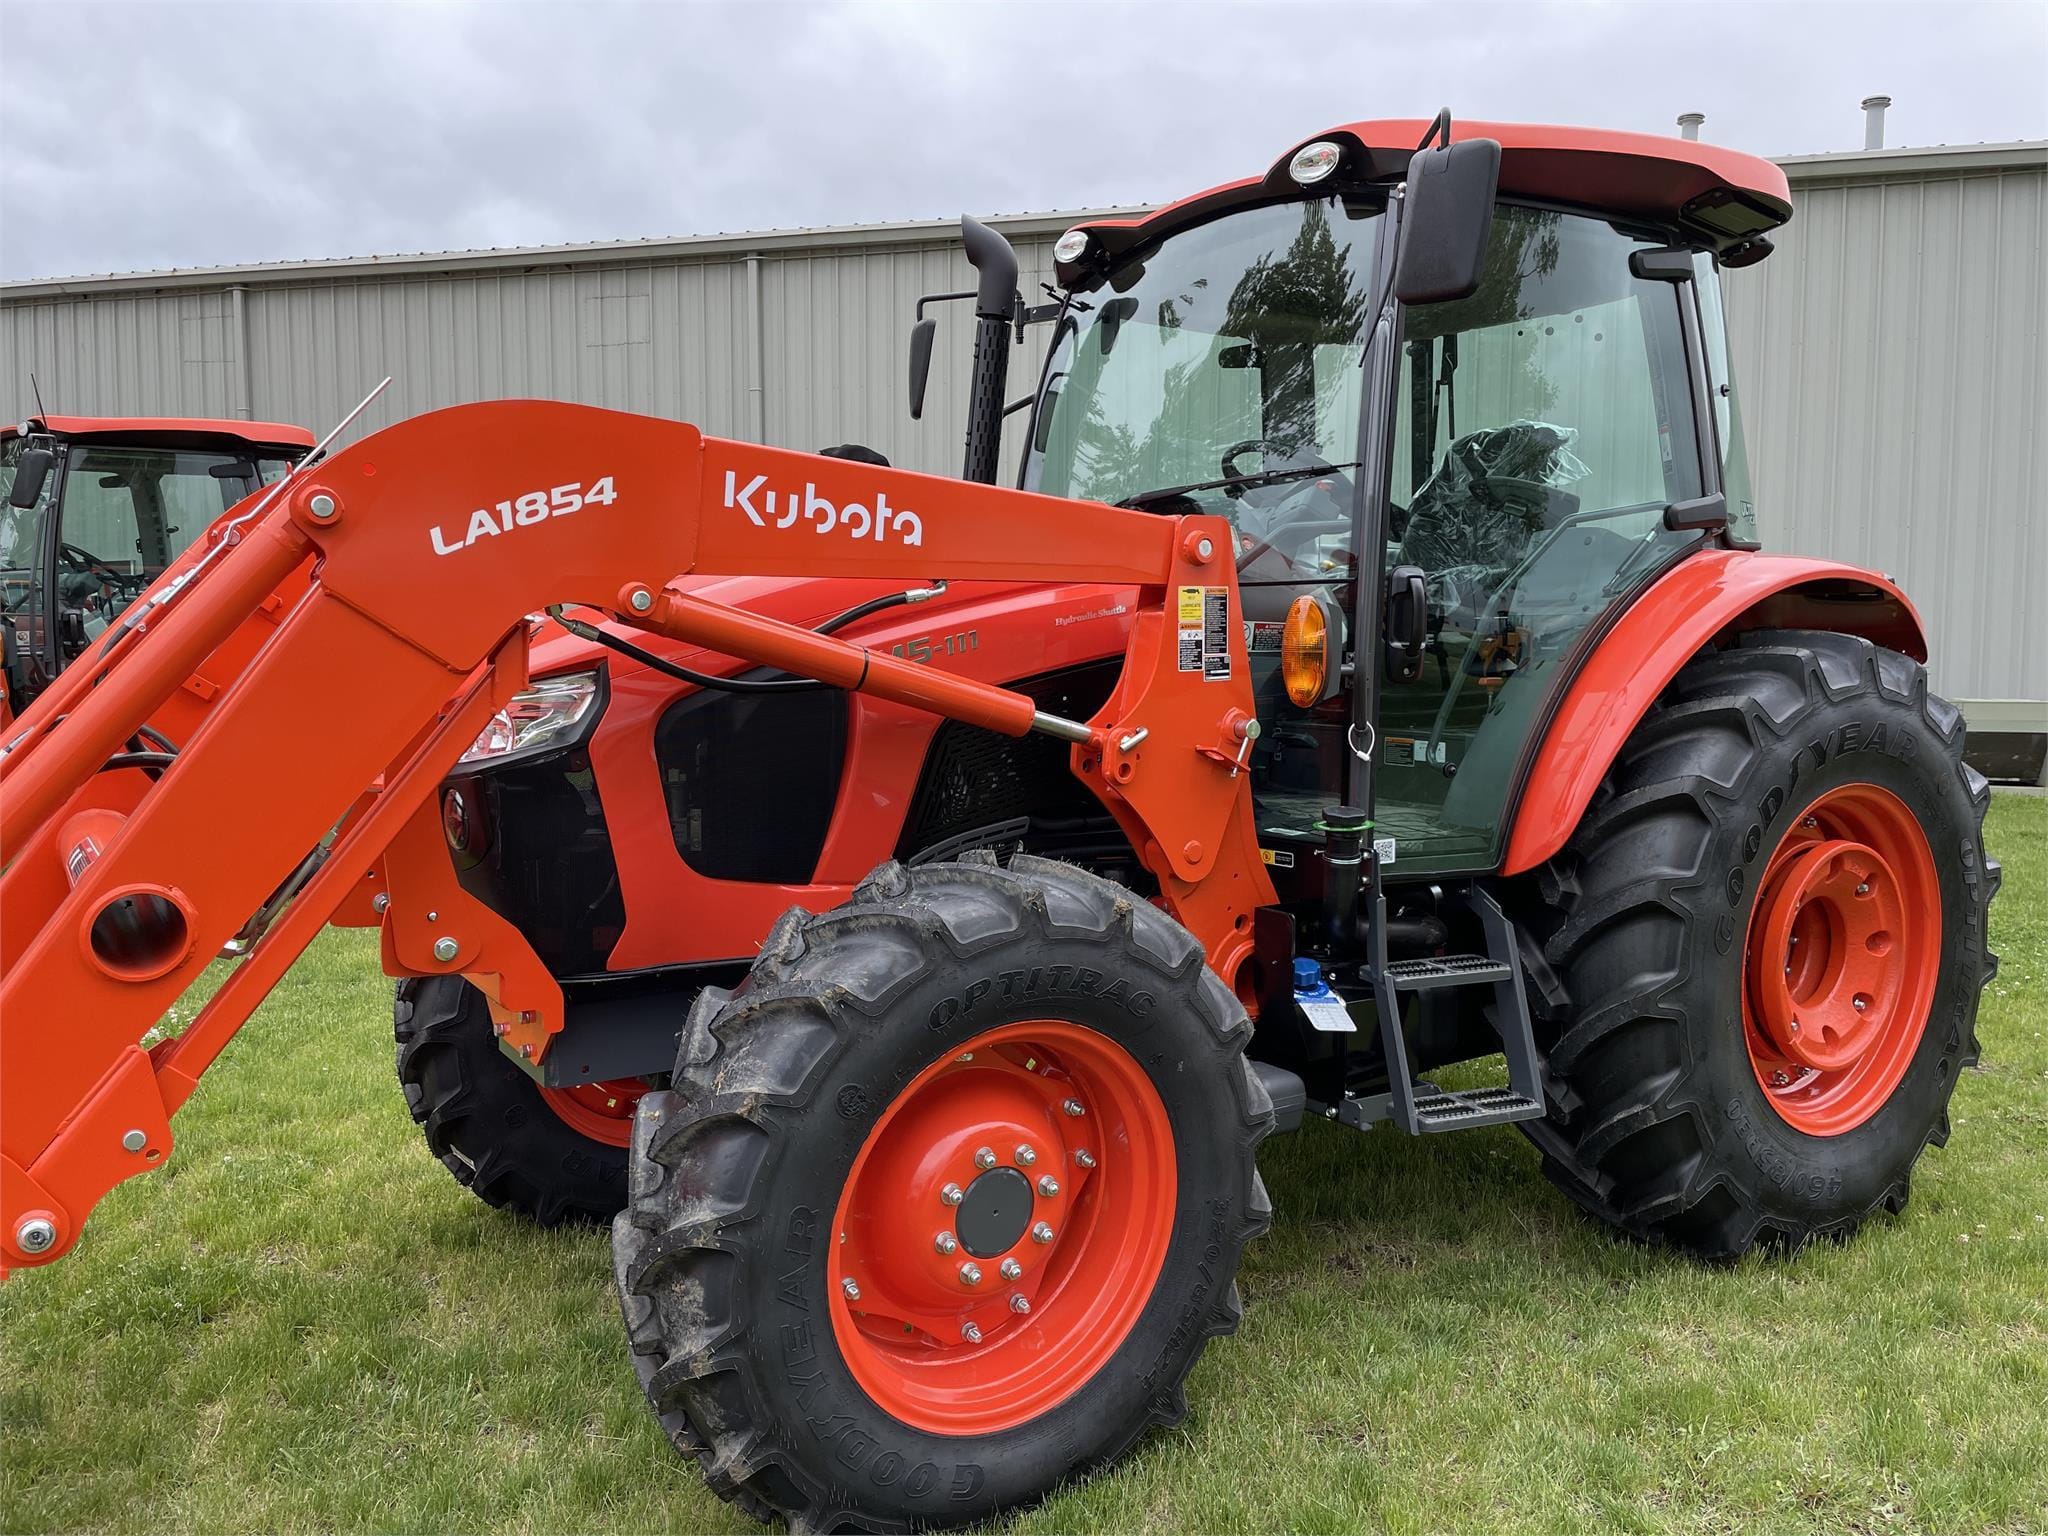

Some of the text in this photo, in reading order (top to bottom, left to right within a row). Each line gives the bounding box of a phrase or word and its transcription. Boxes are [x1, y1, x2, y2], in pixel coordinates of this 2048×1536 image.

[430, 477, 617, 556] LA1854
[724, 470, 923, 546] Kubota
[1055, 605, 1126, 626] Hydraulic Shuttle
[1715, 721, 1919, 955] GOODYEAR
[929, 964, 1157, 1031] OPTITRAC
[777, 1205, 985, 1500] GOODYEAR
